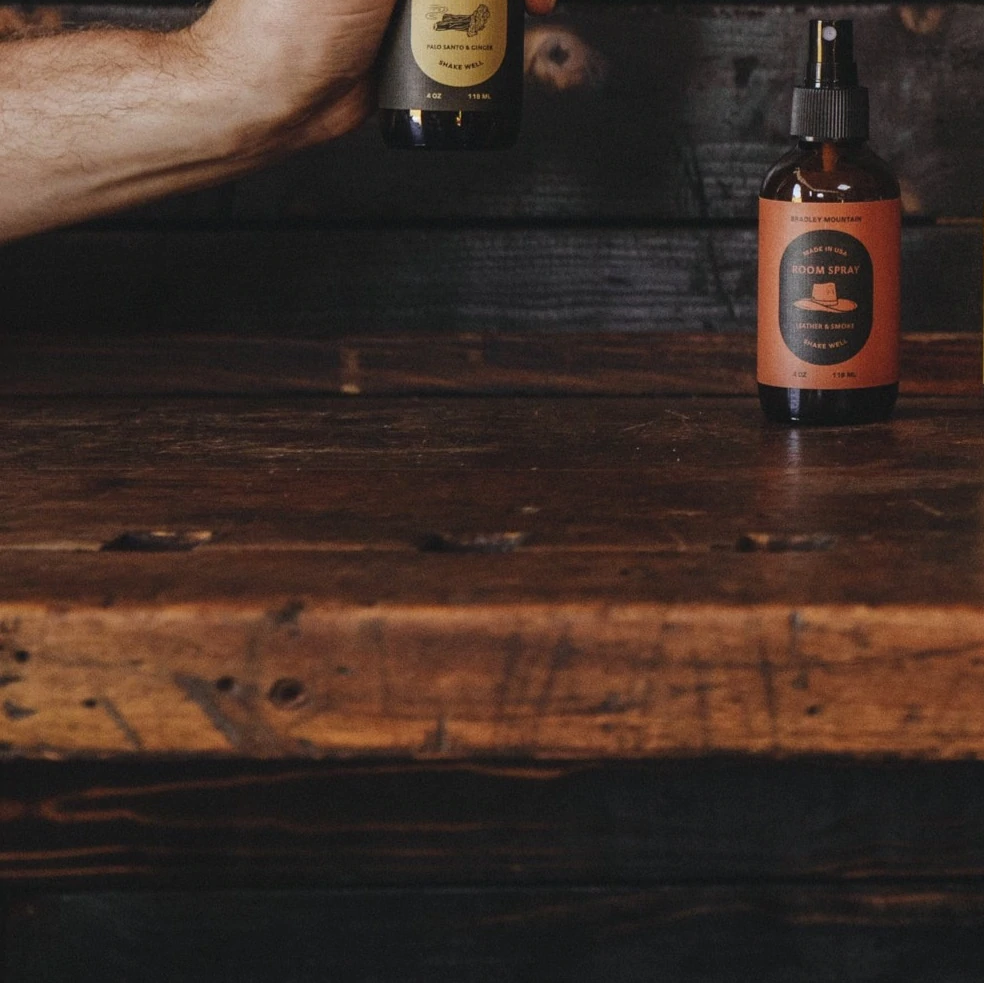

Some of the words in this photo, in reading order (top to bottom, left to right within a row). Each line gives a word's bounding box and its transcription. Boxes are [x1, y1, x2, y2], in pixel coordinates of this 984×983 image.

[439, 60, 462, 70] SHAKE
[464, 61, 484, 69] WELL
[803, 247, 823, 256] MADE
[834, 248, 848, 256] USA
[792, 266, 825, 274] ROOM
[828, 266, 860, 274] SPRAY
[803, 339, 826, 349] SHAKE
[829, 339, 848, 348] WELL
